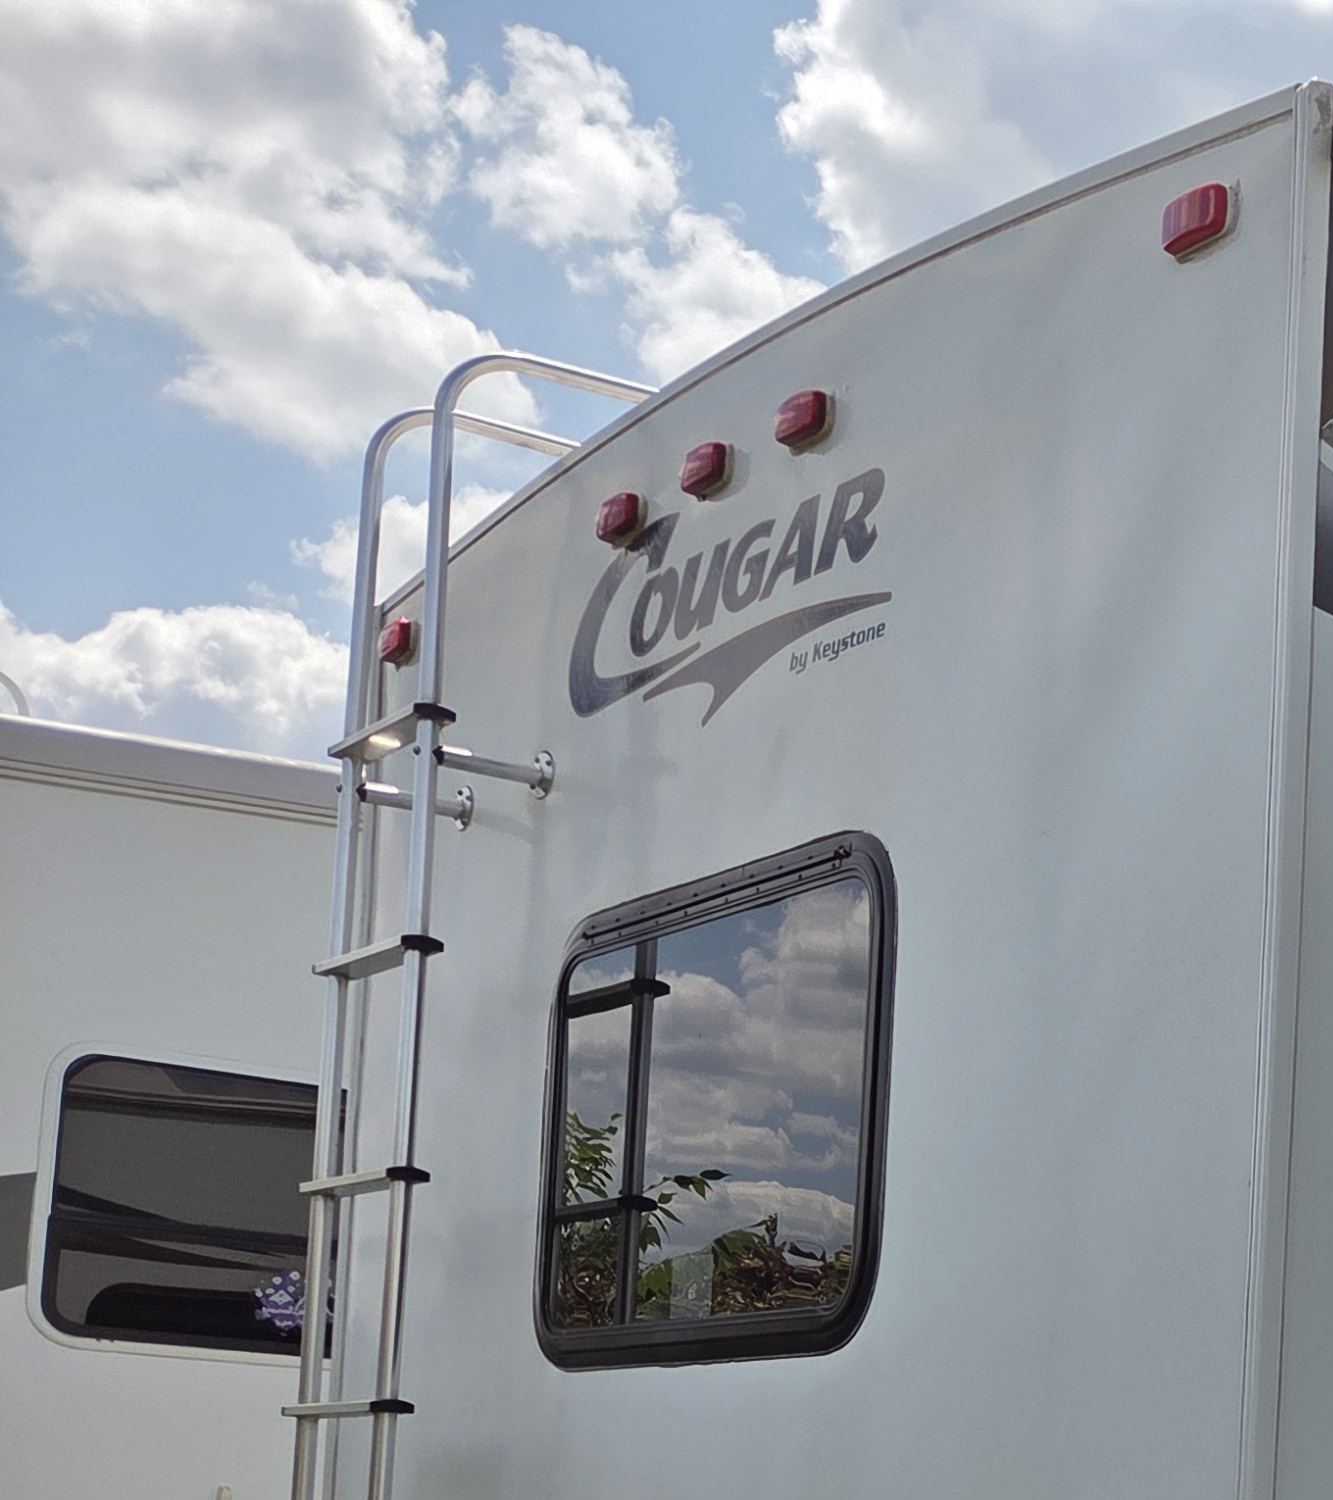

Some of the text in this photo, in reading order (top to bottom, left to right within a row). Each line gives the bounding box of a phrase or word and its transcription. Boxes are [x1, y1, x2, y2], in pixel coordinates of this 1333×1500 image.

[569, 467, 886, 718] COUGAR
[789, 622, 886, 675] by Keystone
